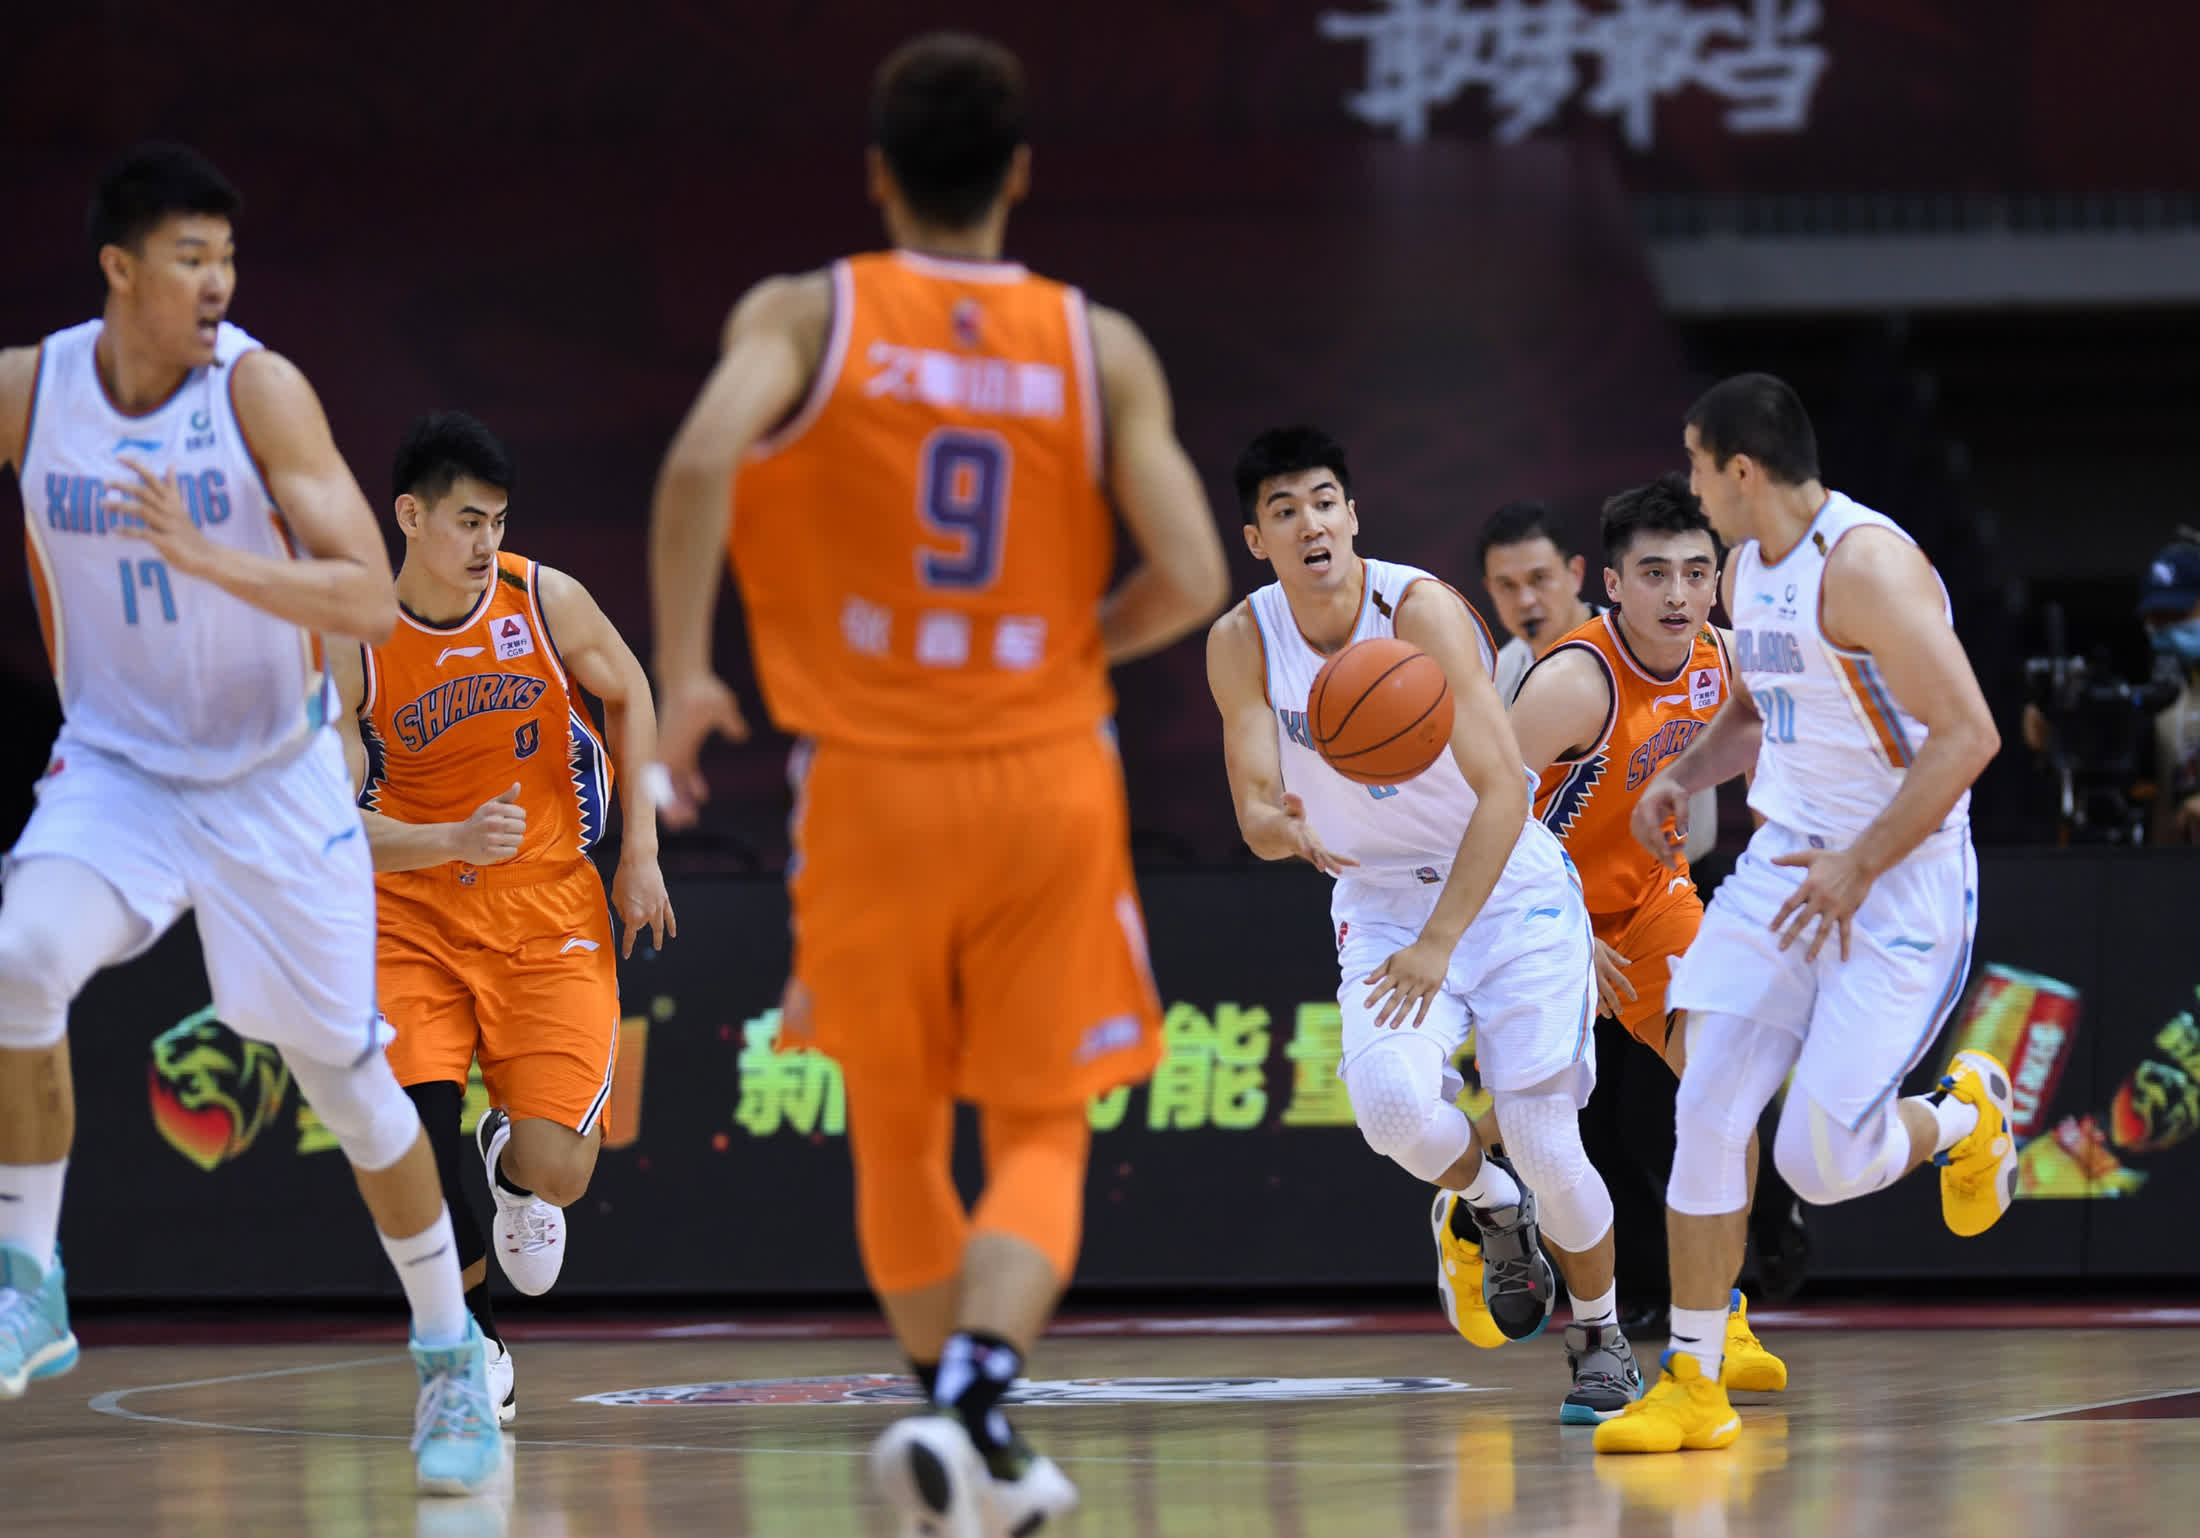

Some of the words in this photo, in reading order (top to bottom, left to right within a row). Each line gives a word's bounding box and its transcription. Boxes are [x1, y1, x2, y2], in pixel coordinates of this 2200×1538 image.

[915, 424, 1013, 593] 9
[118, 556, 178, 626] 17
[506, 647, 525, 658] CGB
[393, 672, 547, 752] SHARKS
[513, 718, 541, 761] 0
[1752, 686, 1797, 744] 20
[1625, 719, 1708, 791] SHAR
